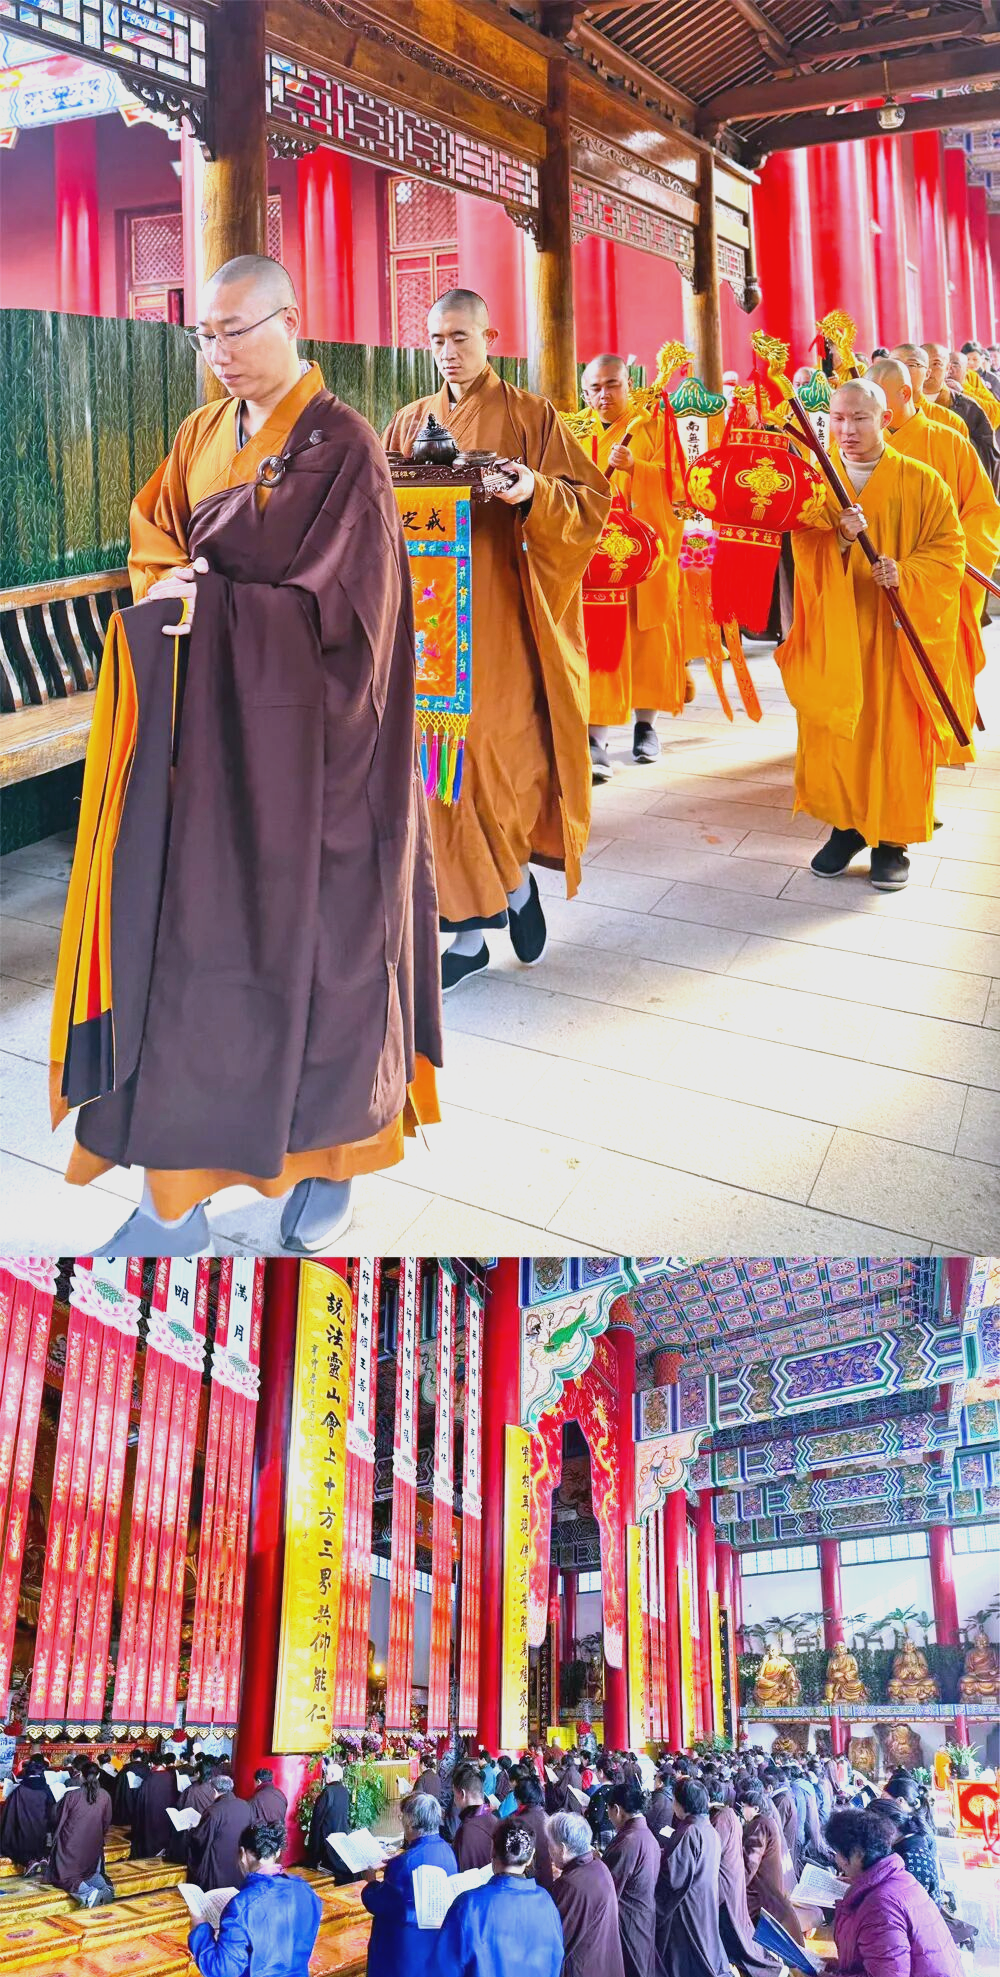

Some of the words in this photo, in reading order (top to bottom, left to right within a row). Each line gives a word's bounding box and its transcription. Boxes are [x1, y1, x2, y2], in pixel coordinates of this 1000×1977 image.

[816, 416, 825, 448] 南無
[357, 1257, 372, 1417] 行普賢願王菩薩
